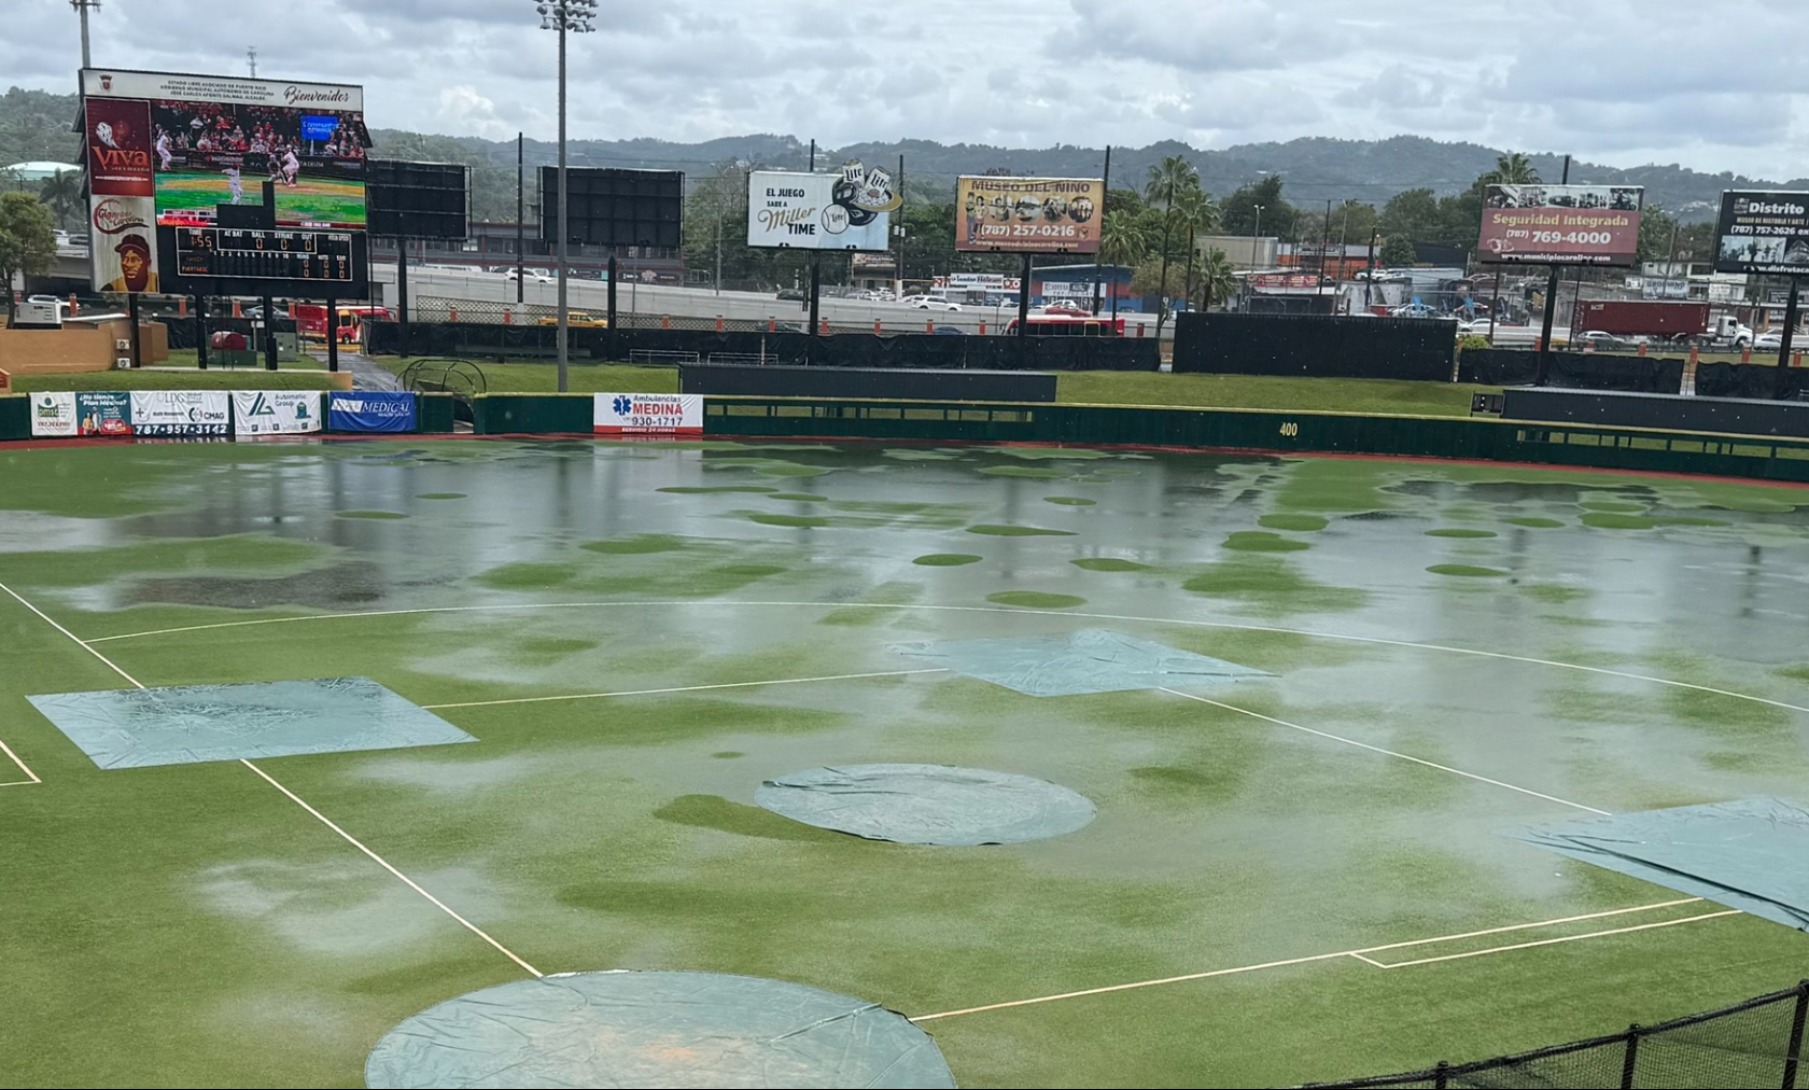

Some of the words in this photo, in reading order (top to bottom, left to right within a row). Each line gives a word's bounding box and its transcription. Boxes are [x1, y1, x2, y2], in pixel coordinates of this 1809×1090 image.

[284, 86, 350, 104] Bienvenidos
[972, 180, 1020, 192] MUSEO
[1025, 182, 1050, 192] DEL
[766, 188, 776, 196] EL
[778, 188, 804, 198] JUEGO
[1749, 202, 1804, 214] Distrito
[757, 207, 818, 232] Miller
[1492, 214, 1560, 226] Seguridad
[1564, 214, 1629, 228] Integrada
[788, 224, 816, 235] TIME
[981, 224, 1010, 236] (787)
[1013, 225, 1075, 236] 257-0216
[1730, 225, 1753, 234] (787)
[1756, 226, 1796, 235] 757-2626
[1506, 229, 1529, 238] (787)
[1532, 230, 1612, 244] 769-4000
[256, 238, 263, 250] 0
[280, 239, 288, 250] 0
[305, 240, 312, 251] 0
[362, 402, 410, 412] MEDICAL
[632, 403, 683, 415] MEDINA
[632, 417, 683, 426] 930-1717
[1280, 422, 1298, 436] 400
